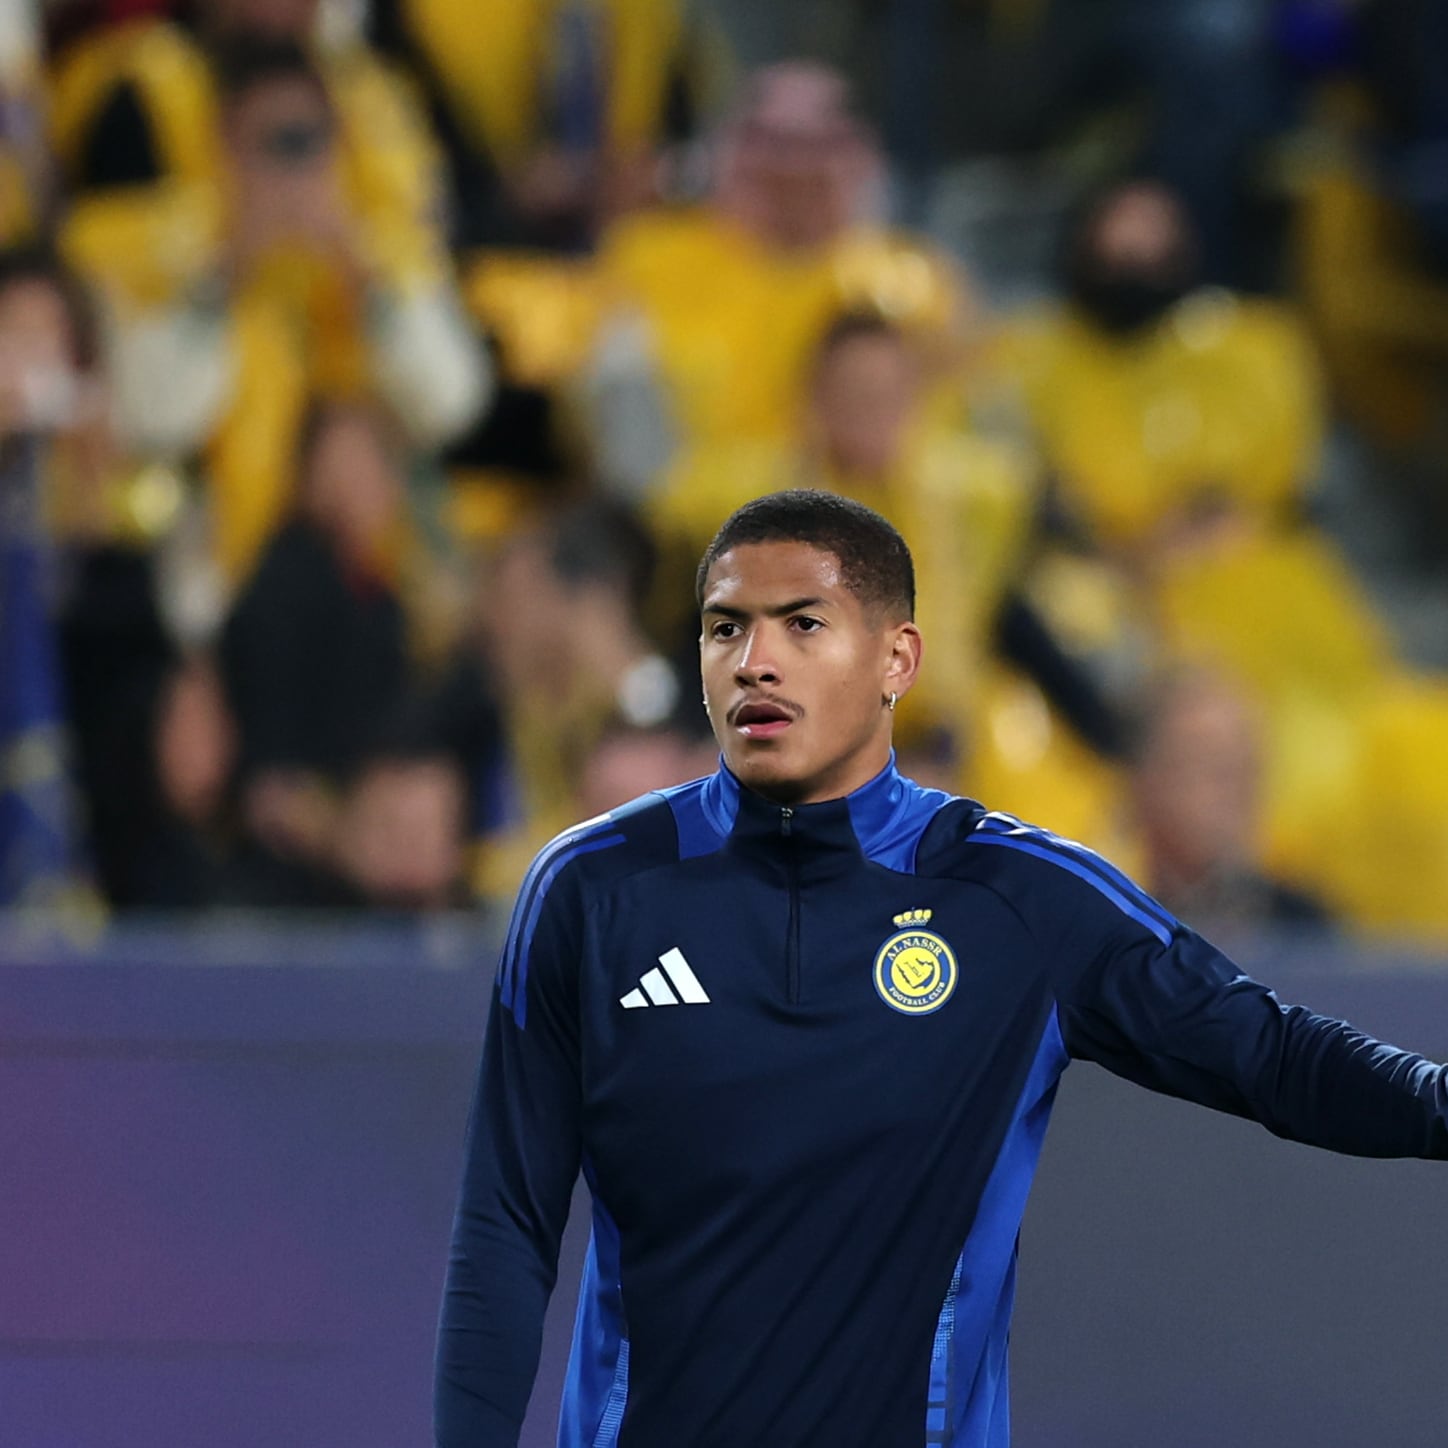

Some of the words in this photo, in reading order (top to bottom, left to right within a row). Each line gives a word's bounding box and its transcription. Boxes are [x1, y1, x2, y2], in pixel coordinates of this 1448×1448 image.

[887, 944, 903, 961] AL
[902, 937, 943, 958] NASSR
[889, 986, 928, 1006] FOOTBALL
[928, 981, 946, 1001] CLUB
